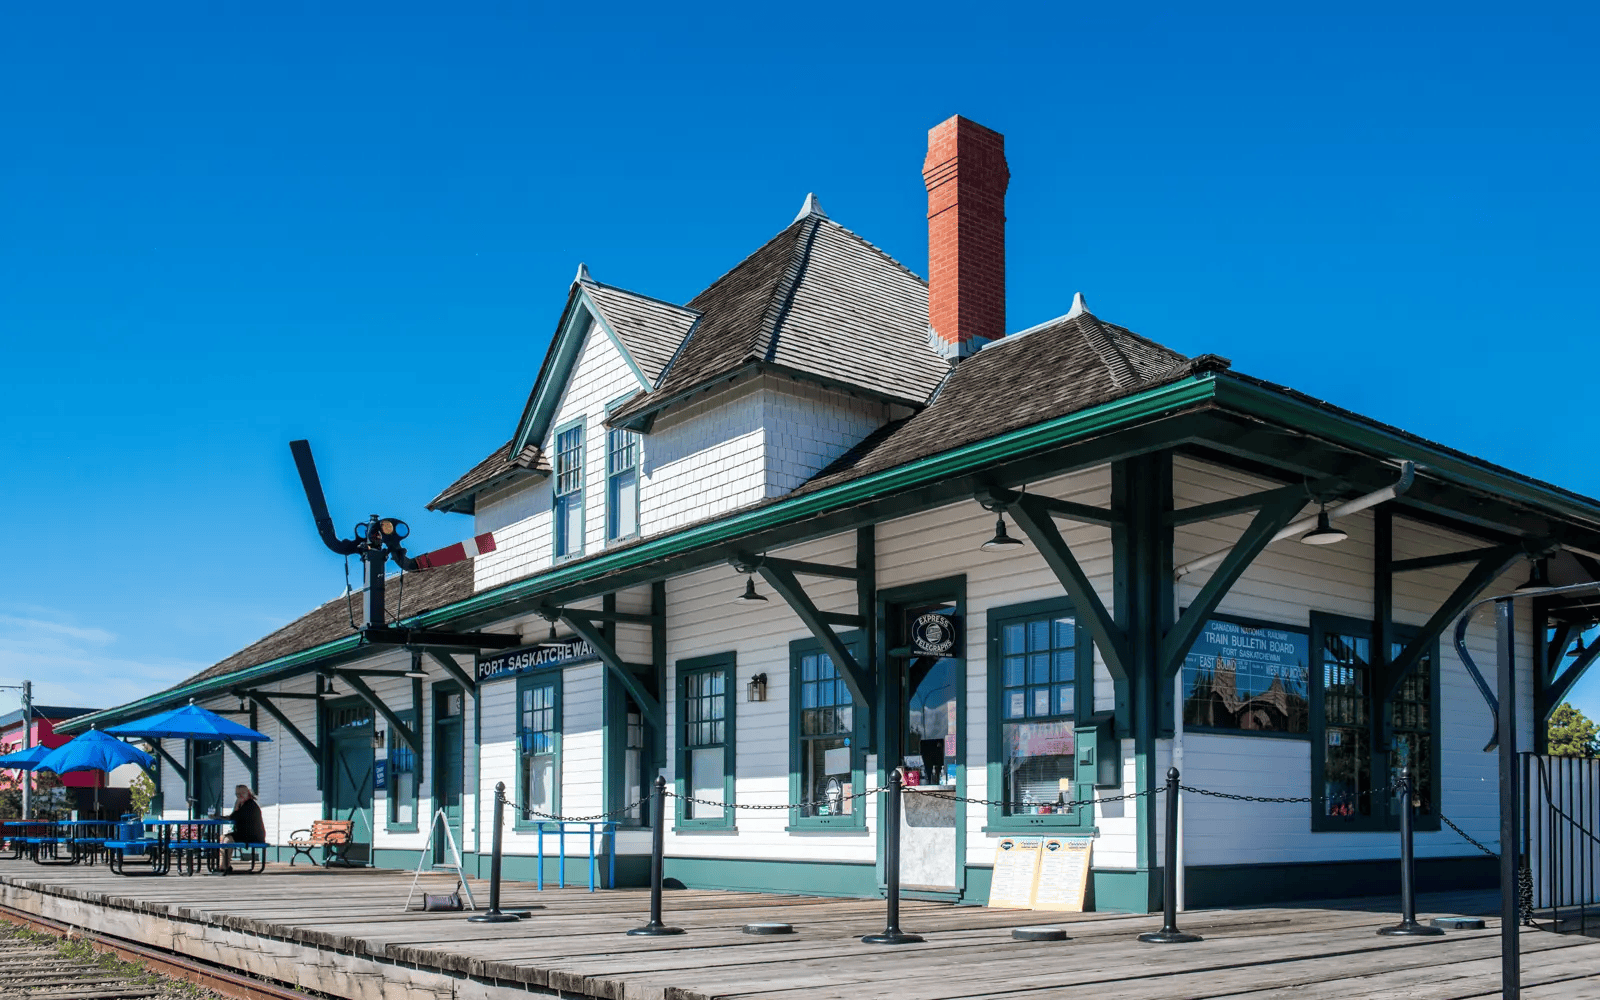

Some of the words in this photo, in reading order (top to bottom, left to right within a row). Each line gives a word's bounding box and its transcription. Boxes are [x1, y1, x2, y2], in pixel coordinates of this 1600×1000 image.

[918, 614, 948, 628] EXPRESS
[1212, 622, 1239, 633] CANADIAN
[1240, 626, 1266, 637] NATIONAL
[916, 636, 952, 651] TELEGRAPHS
[1205, 631, 1228, 645] TRAIN
[1231, 635, 1267, 650] BULLETIN
[1269, 640, 1295, 654] BOARD
[1222, 647, 1237, 656] FORT
[1240, 650, 1280, 662] SASKATCHEWAN
[478, 658, 505, 677] FORT
[1200, 656, 1215, 668] EAST
[1216, 658, 1236, 670] BOUND
